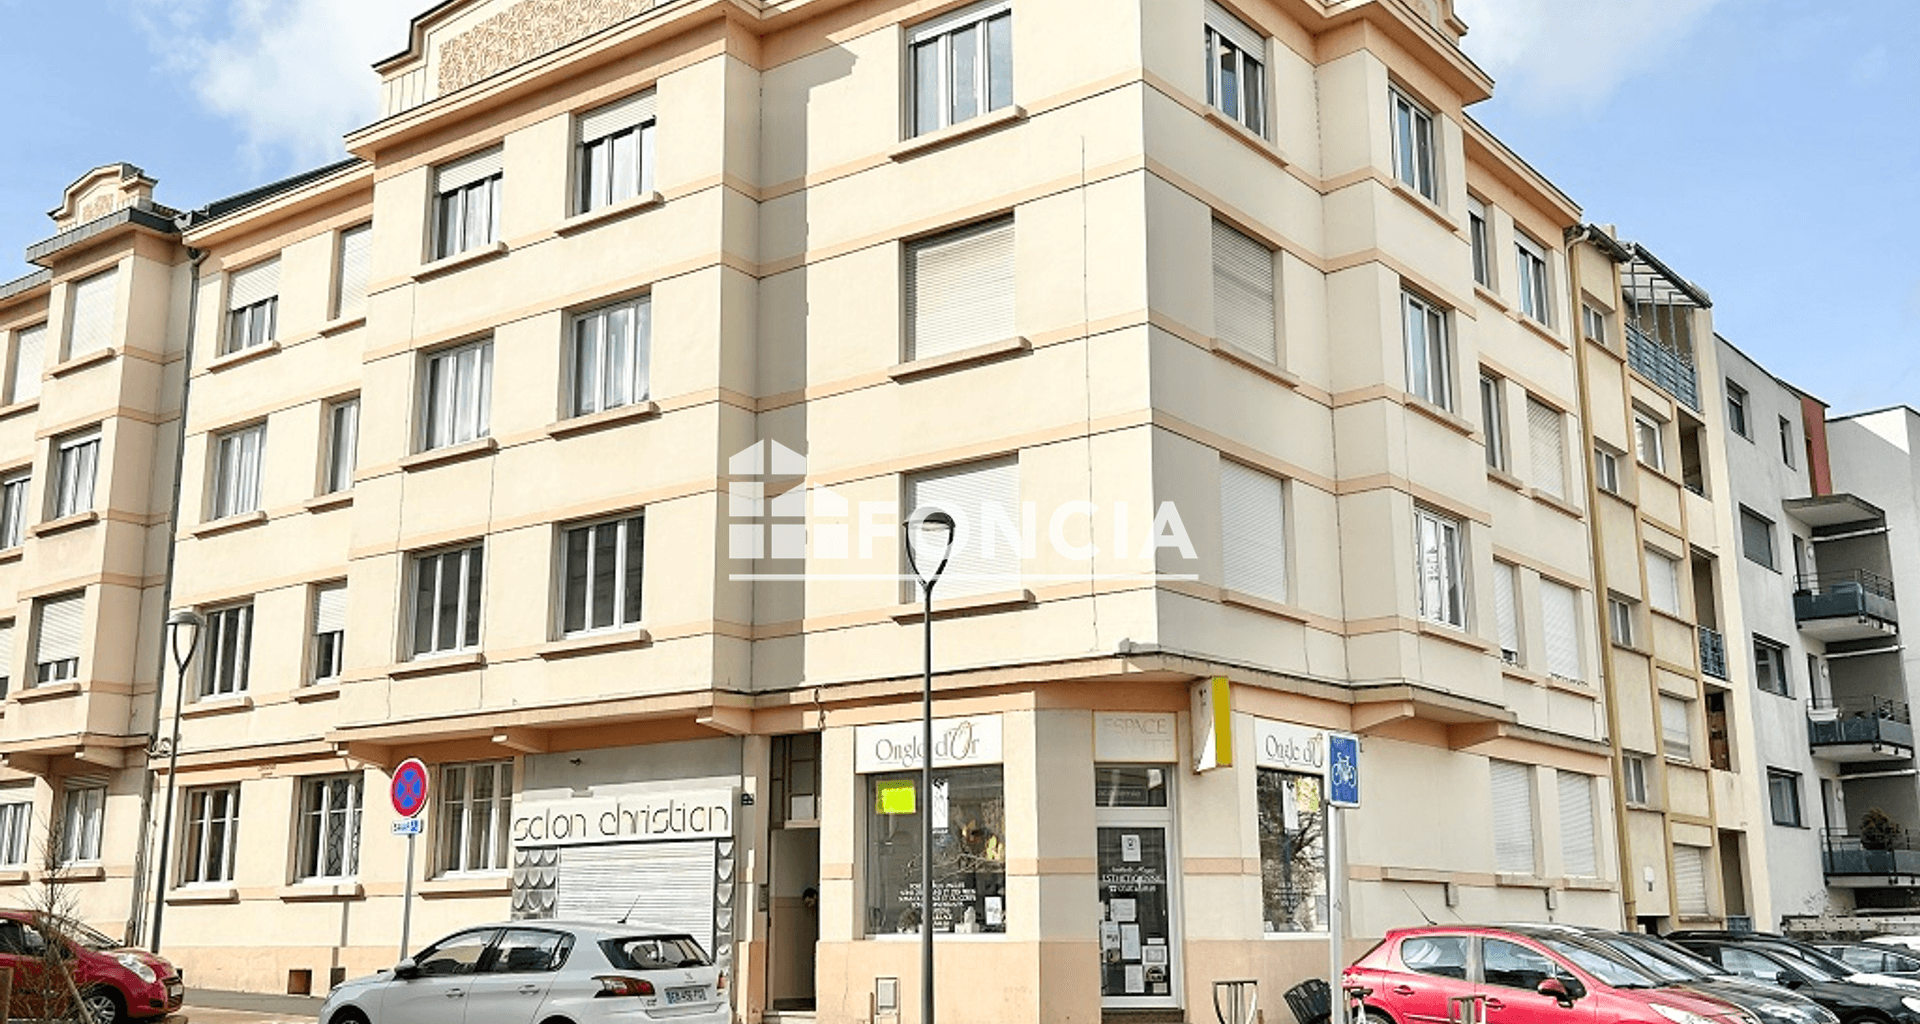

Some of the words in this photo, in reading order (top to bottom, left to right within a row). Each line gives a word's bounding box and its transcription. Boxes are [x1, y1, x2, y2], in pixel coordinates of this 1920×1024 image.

[1104, 717, 1167, 735] ESPACE
[514, 807, 587, 841] salon
[599, 799, 729, 836] christian
